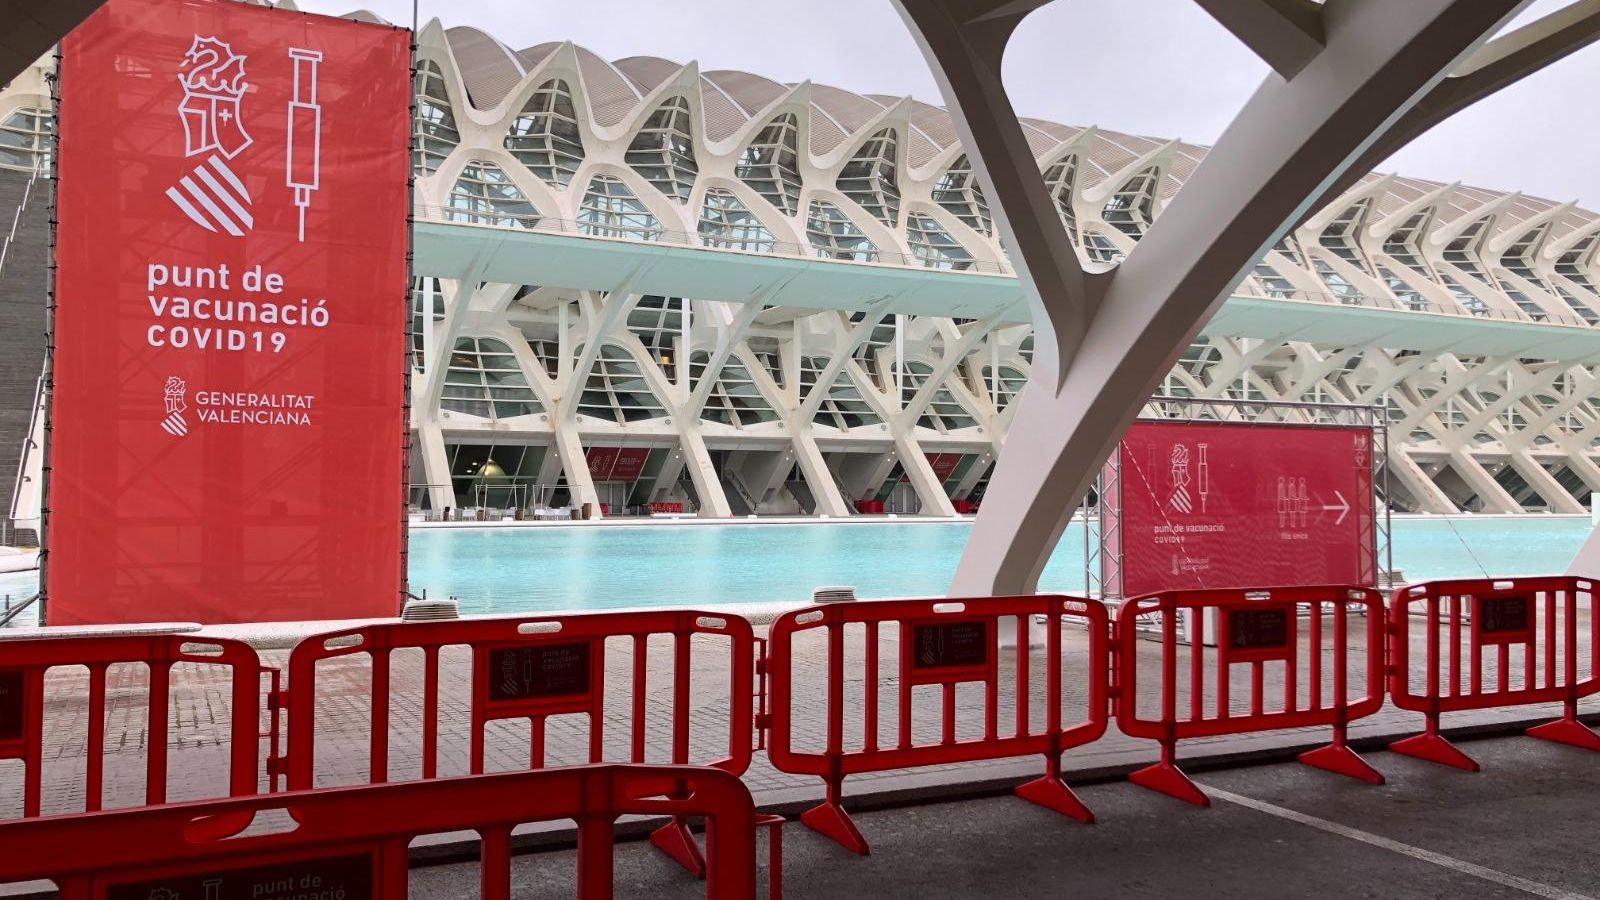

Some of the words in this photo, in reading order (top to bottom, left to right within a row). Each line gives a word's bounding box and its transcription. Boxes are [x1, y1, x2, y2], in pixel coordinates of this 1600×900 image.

[147, 263, 230, 292] punt
[242, 264, 284, 294] de
[148, 295, 330, 327] vacunació
[147, 324, 287, 353] COVID19
[195, 391, 315, 409] GENERALITAT
[197, 408, 312, 426] VALENCIANA
[1173, 524, 1184, 532] de
[252, 876, 294, 899] punt
[299, 873, 322, 889] de
[263, 885, 346, 900] nació
